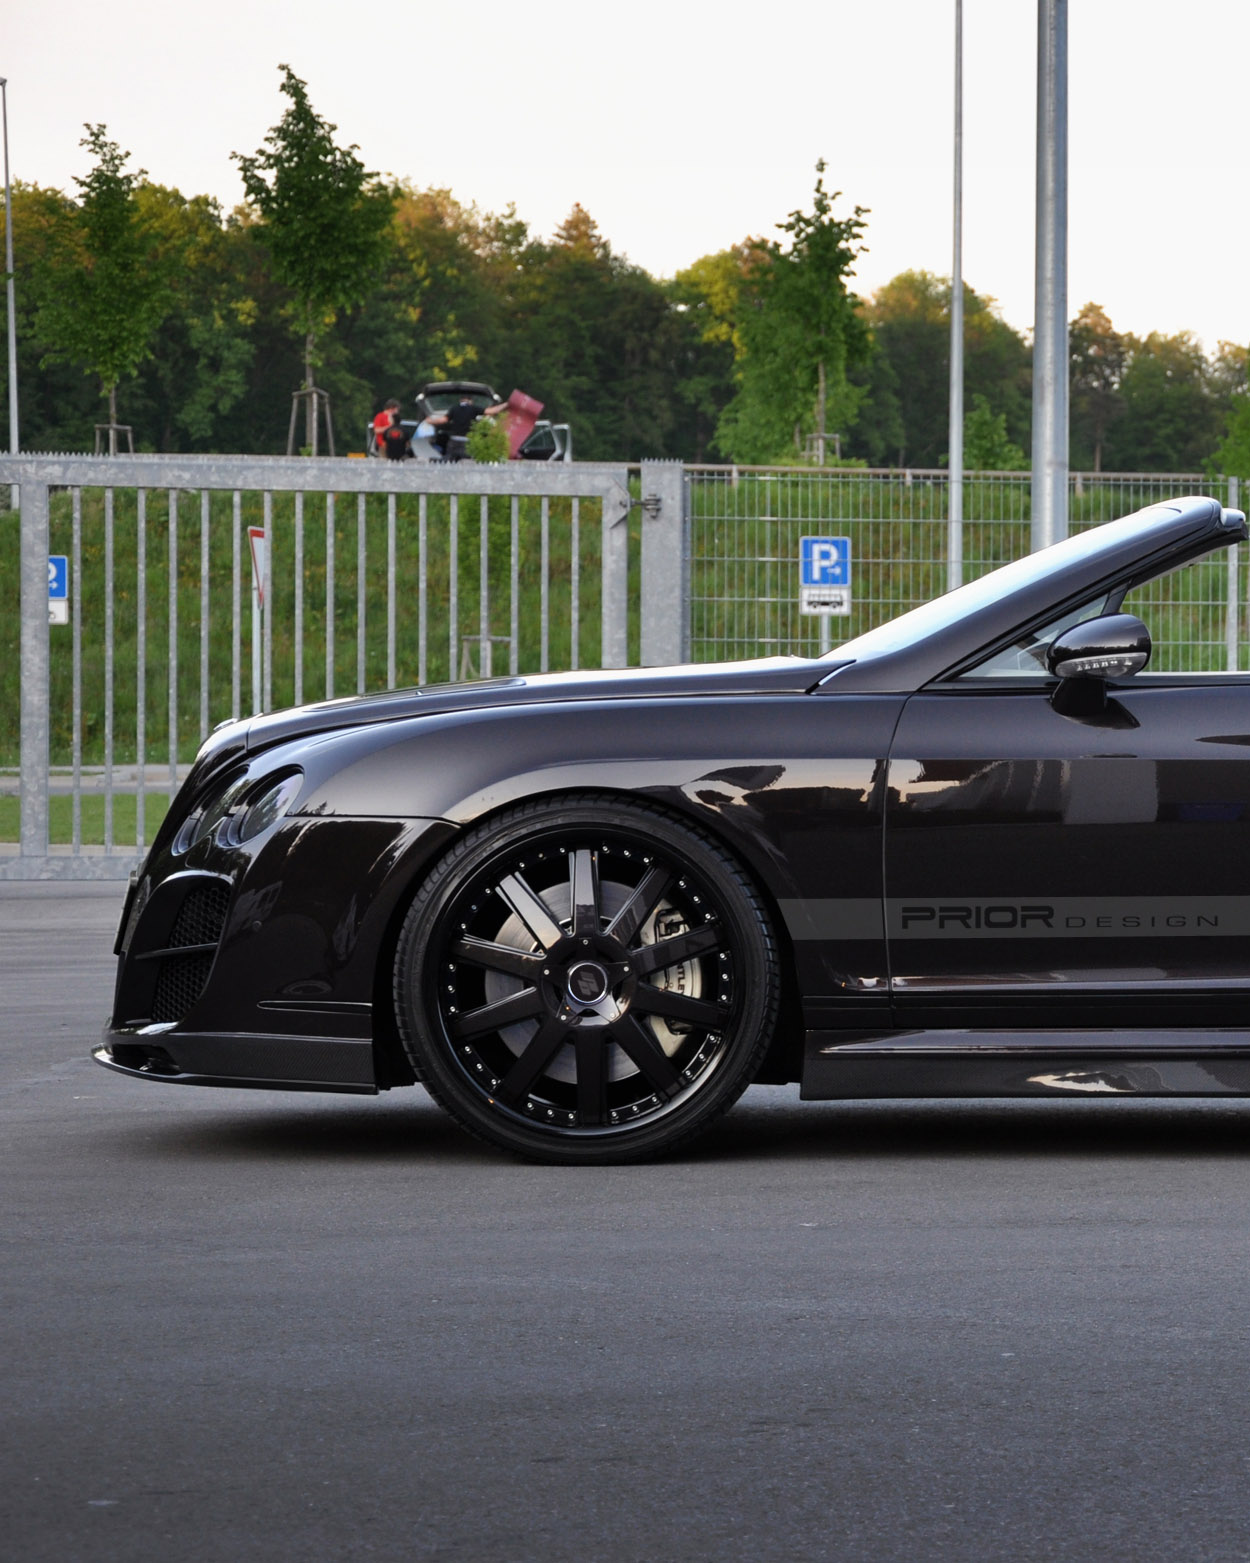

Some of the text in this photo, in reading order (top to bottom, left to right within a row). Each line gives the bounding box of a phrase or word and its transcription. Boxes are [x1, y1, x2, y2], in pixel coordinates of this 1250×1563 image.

[812, 543, 839, 580] P
[902, 905, 1219, 930] PRIOR DESIGN
